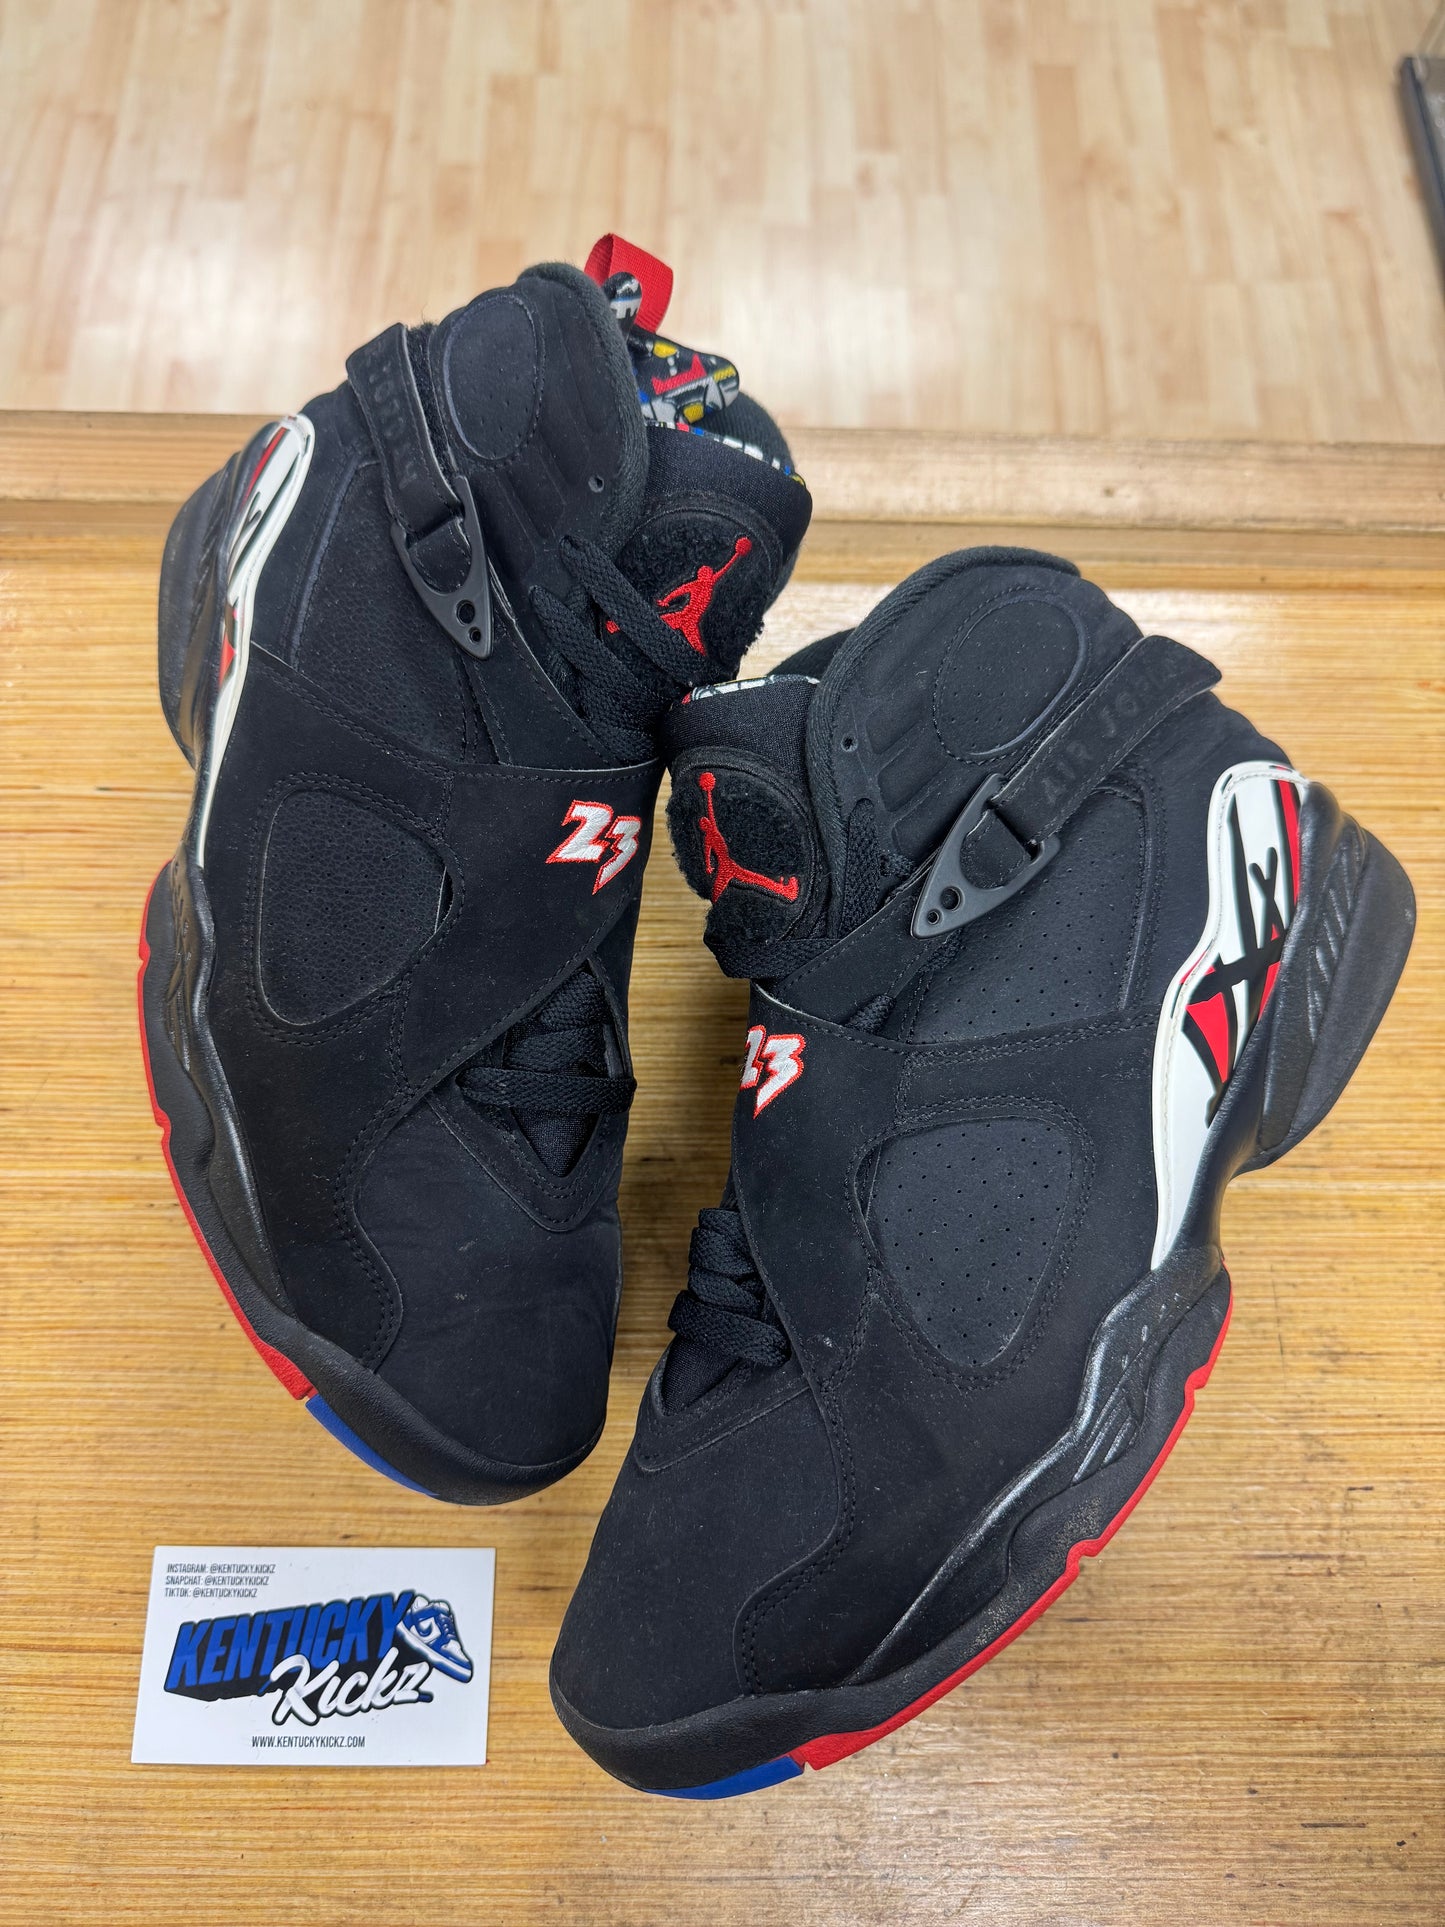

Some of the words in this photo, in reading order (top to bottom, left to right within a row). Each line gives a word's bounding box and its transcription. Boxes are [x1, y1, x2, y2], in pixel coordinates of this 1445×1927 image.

[545, 800, 642, 895] 23
[167, 1563, 208, 1573] INSTAGRAM:
[165, 1575, 203, 1585] SNAPCHAT:
[204, 1575, 270, 1586] @KENTUCKYKICKZ
[164, 1588, 191, 1597] TIKTOK:
[192, 1587, 258, 1598] @KENTUCKYKICKZ
[165, 1591, 415, 1702] KENTUCKY
[271, 1646, 430, 1726] Kickz
[251, 1736, 365, 1748] WWW.KENTUCKYKICKZ.COM
